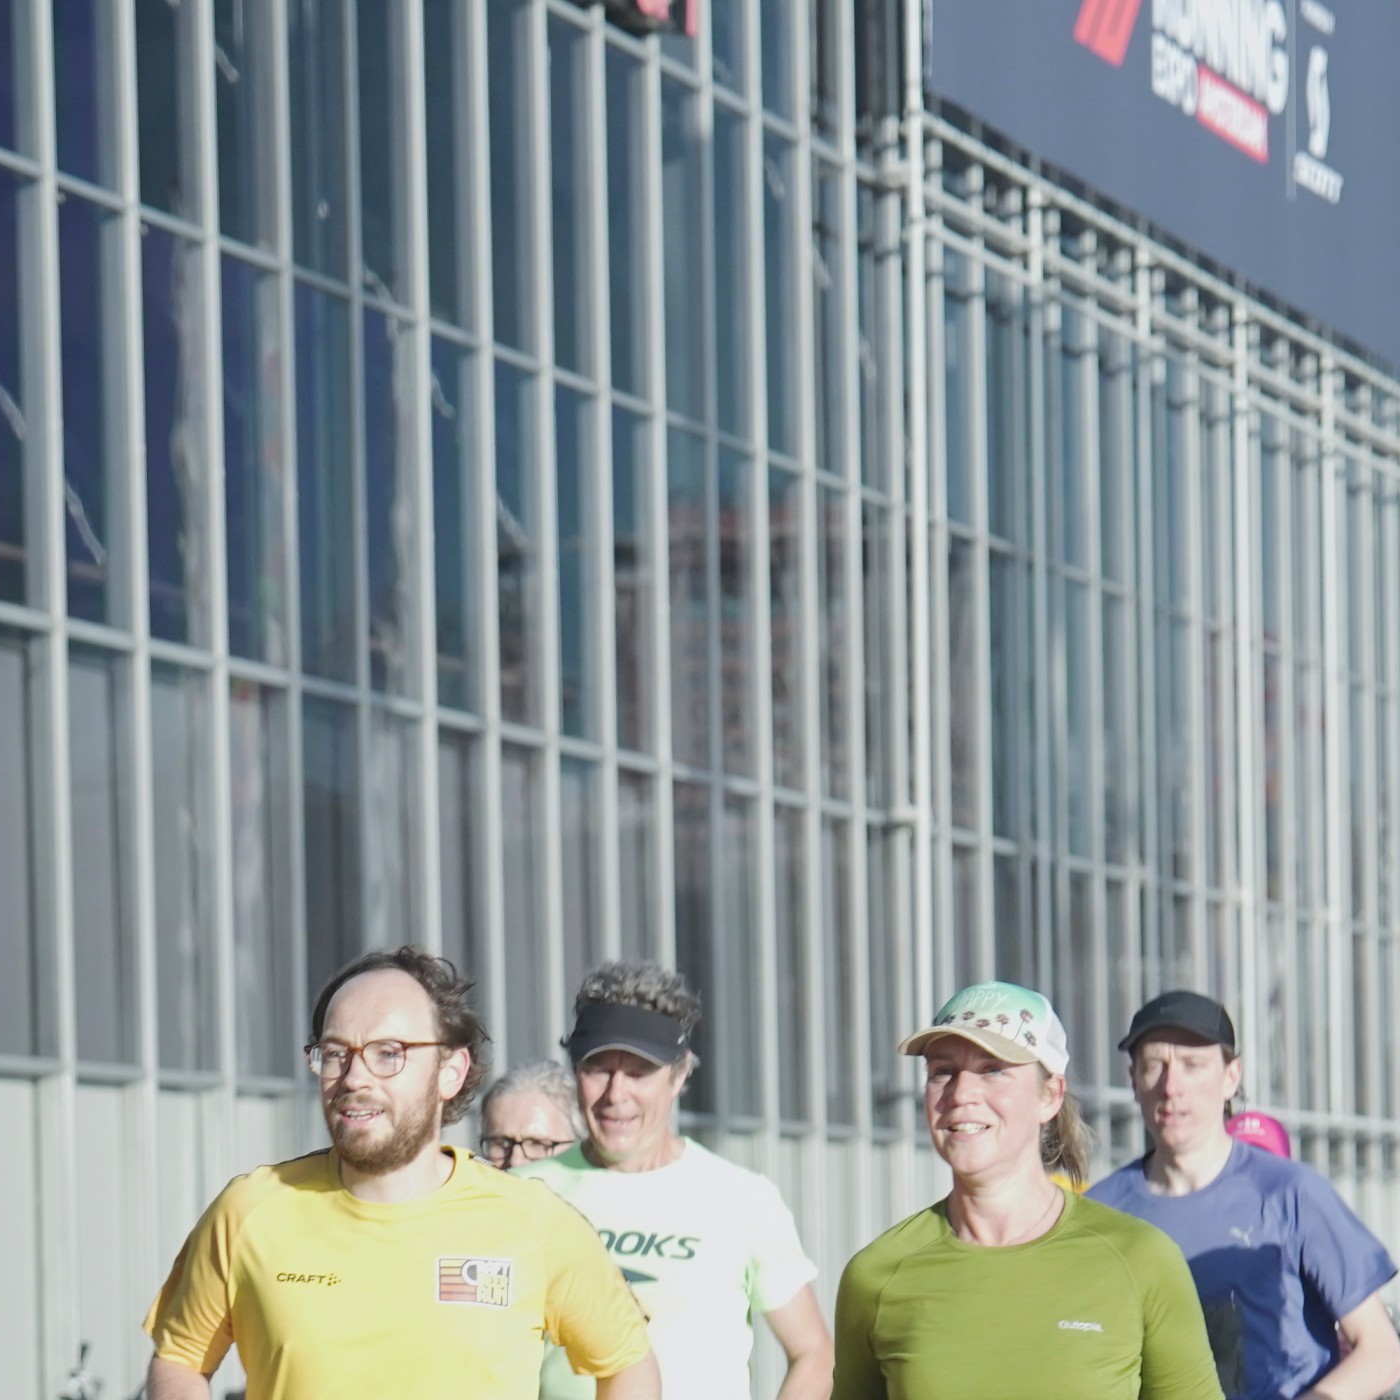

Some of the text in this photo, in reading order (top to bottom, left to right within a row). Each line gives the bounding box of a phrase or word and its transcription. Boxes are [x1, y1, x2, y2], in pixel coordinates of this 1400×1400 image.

[1152, 0, 1289, 115] NNING
[953, 990, 1009, 1010] HAPPY
[276, 1272, 327, 1284] CRAFT
